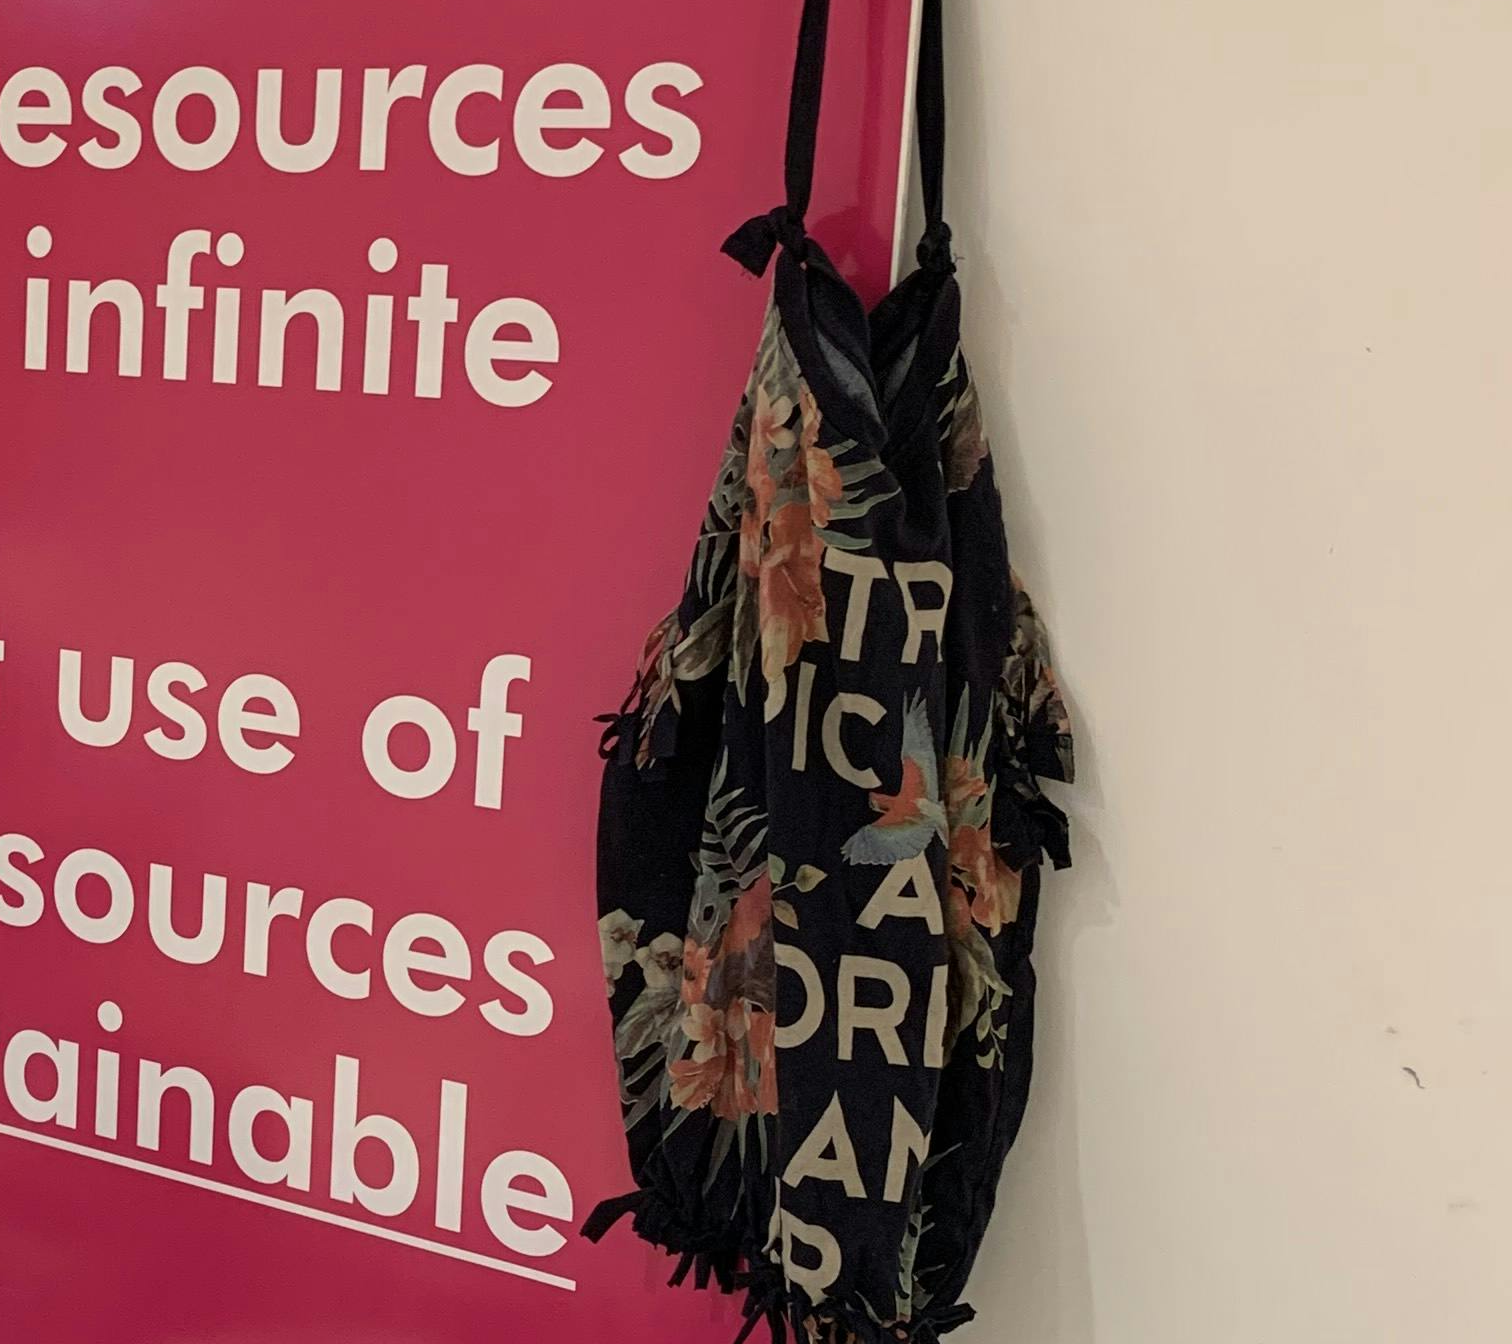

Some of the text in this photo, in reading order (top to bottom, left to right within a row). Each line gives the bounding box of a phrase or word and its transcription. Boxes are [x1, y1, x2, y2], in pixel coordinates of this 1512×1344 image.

[25, 226, 559, 407] infinite
[59, 649, 300, 773] use
[362, 655, 530, 809] of
